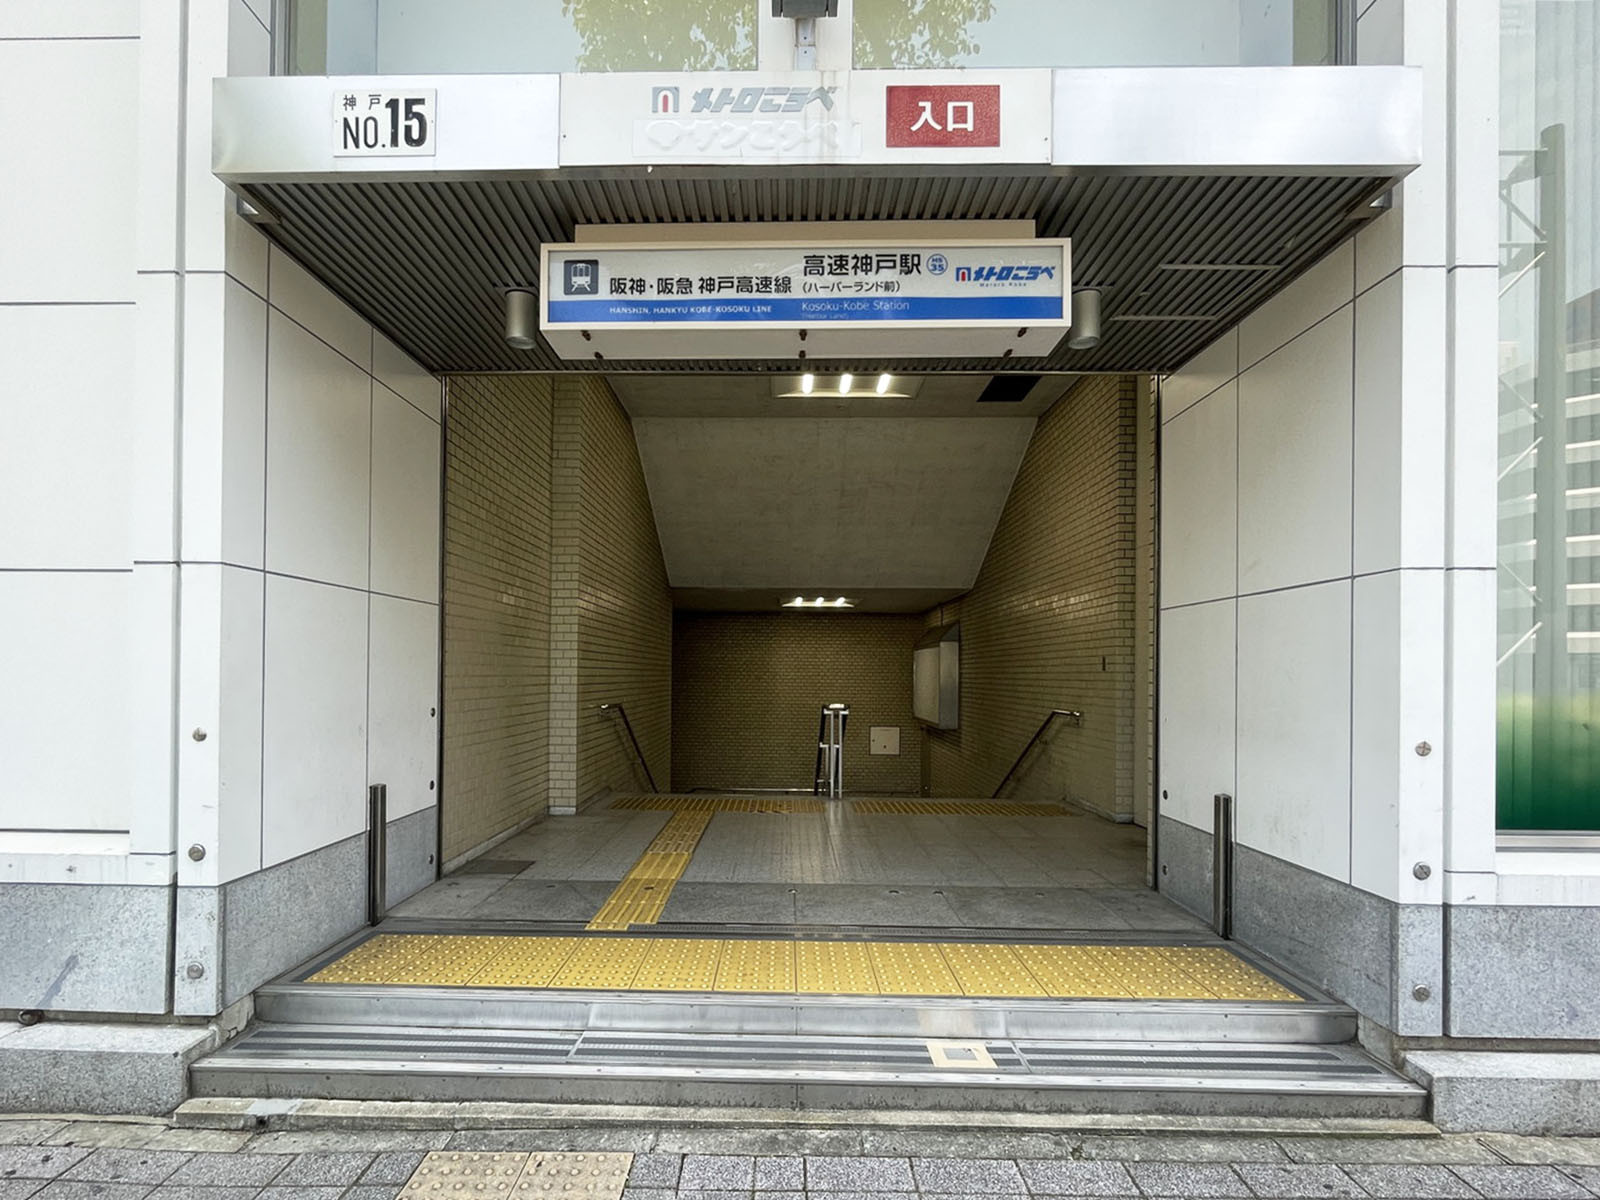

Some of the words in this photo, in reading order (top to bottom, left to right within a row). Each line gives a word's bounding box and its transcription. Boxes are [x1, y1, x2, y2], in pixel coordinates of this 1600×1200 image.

[342, 94, 382, 111] 神戸
[690, 86, 837, 113] メトロこうべ
[910, 101, 974, 132] 入口
[803, 253, 922, 277] 高速神戸駅
[930, 263, 945, 271] 35
[973, 266, 1056, 281] メトロこうべ
[697, 276, 792, 294] 神戸高速線
[653, 306, 689, 314] HANKYU
[752, 305, 773, 313] LINE
[801, 301, 870, 311] Kosoku-Kobe
[872, 300, 910, 311] Station
